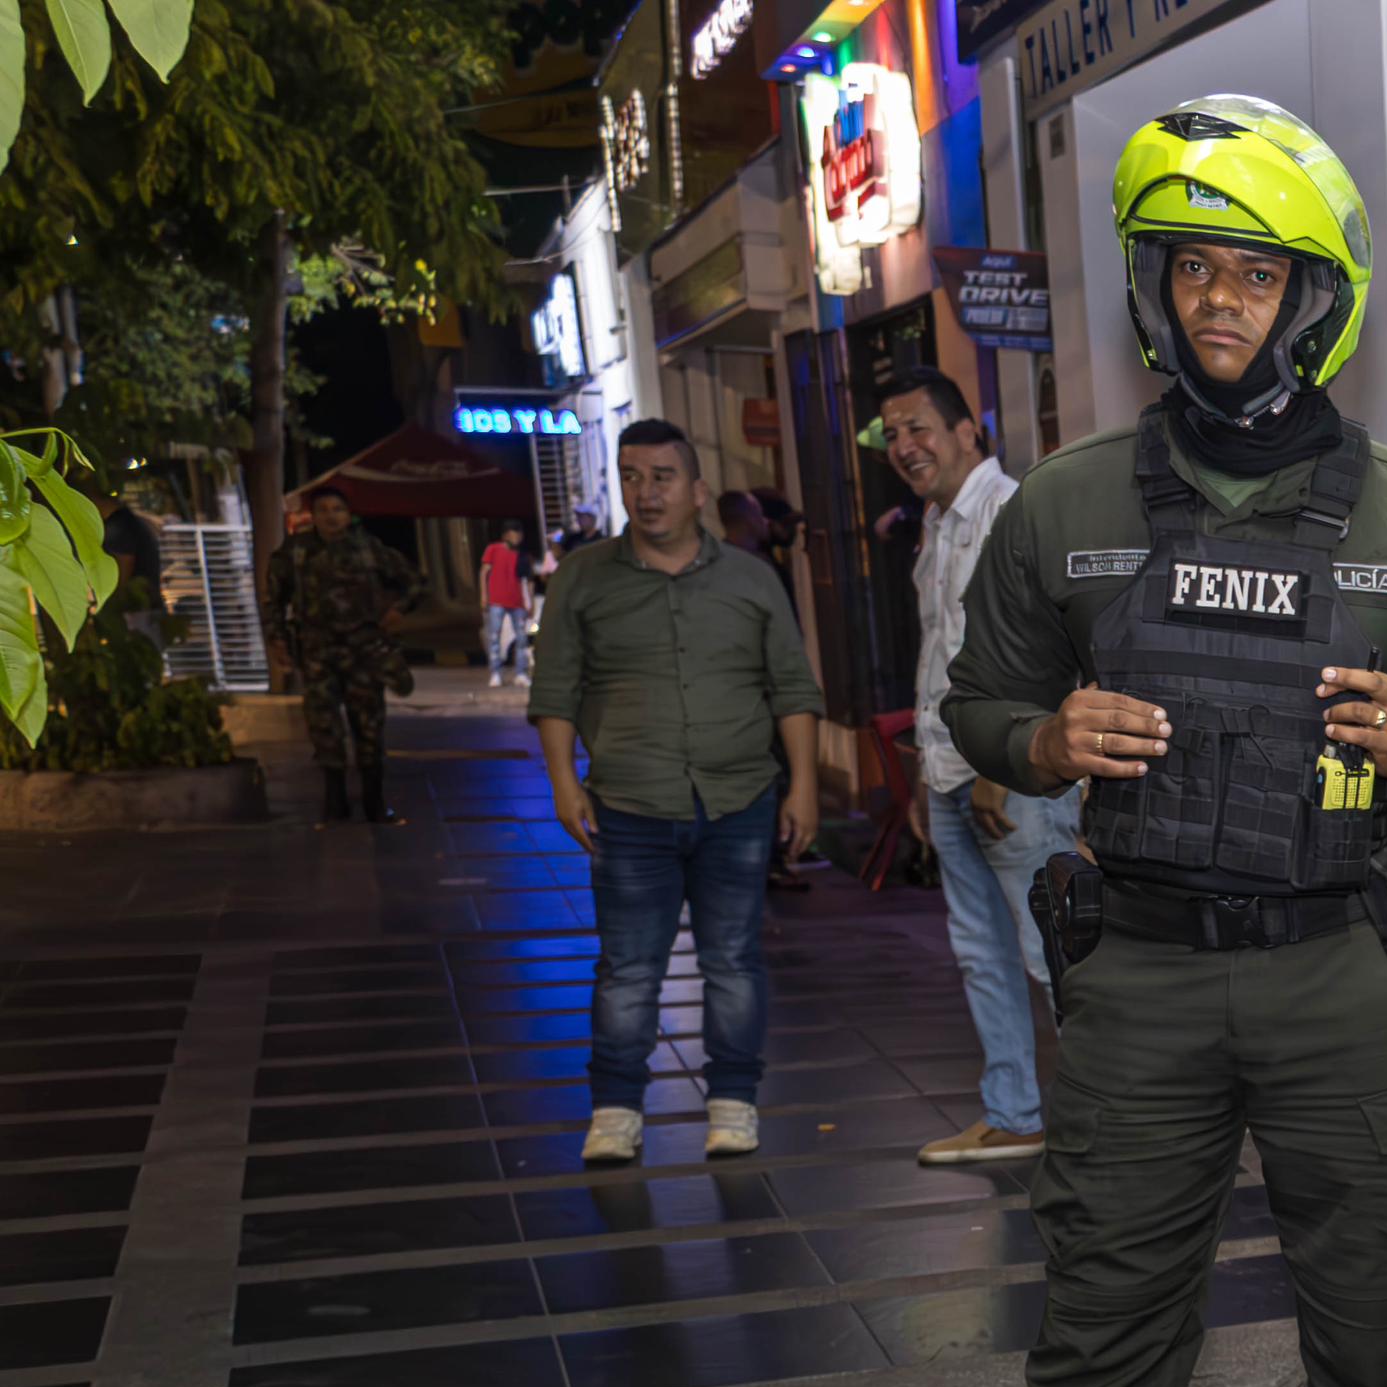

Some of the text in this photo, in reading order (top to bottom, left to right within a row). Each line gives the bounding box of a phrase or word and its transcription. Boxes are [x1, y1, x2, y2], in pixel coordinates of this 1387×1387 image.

[1024, 0, 1113, 98] TALLER
[963, 270, 1028, 286] TEST
[959, 286, 1049, 306] DRIVE
[539, 408, 581, 434] LA
[1112, 560, 1146, 572] RENT
[1171, 563, 1299, 616] FENIX
